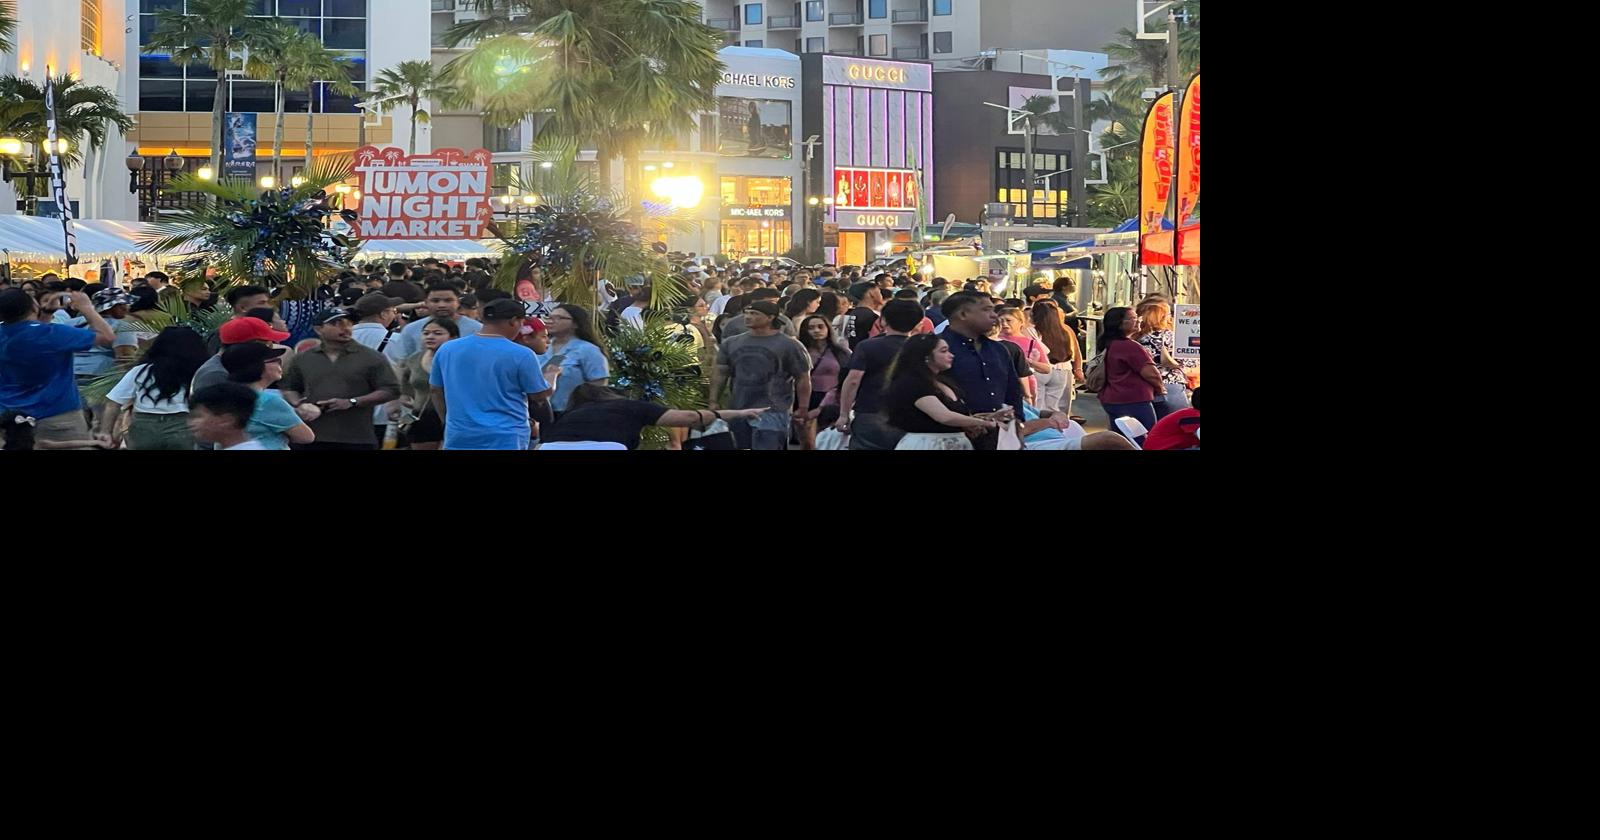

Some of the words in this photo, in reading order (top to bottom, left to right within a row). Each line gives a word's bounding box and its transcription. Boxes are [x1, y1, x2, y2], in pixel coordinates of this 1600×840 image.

[722, 73, 760, 87] CHAEL
[764, 76, 795, 89] KORS
[849, 64, 904, 83] GUCCI
[355, 166, 488, 194] TUMON
[363, 195, 484, 218] NIGHT
[764, 208, 785, 217] KORS
[361, 219, 483, 237] MARKET
[856, 214, 898, 226] GUCCI
